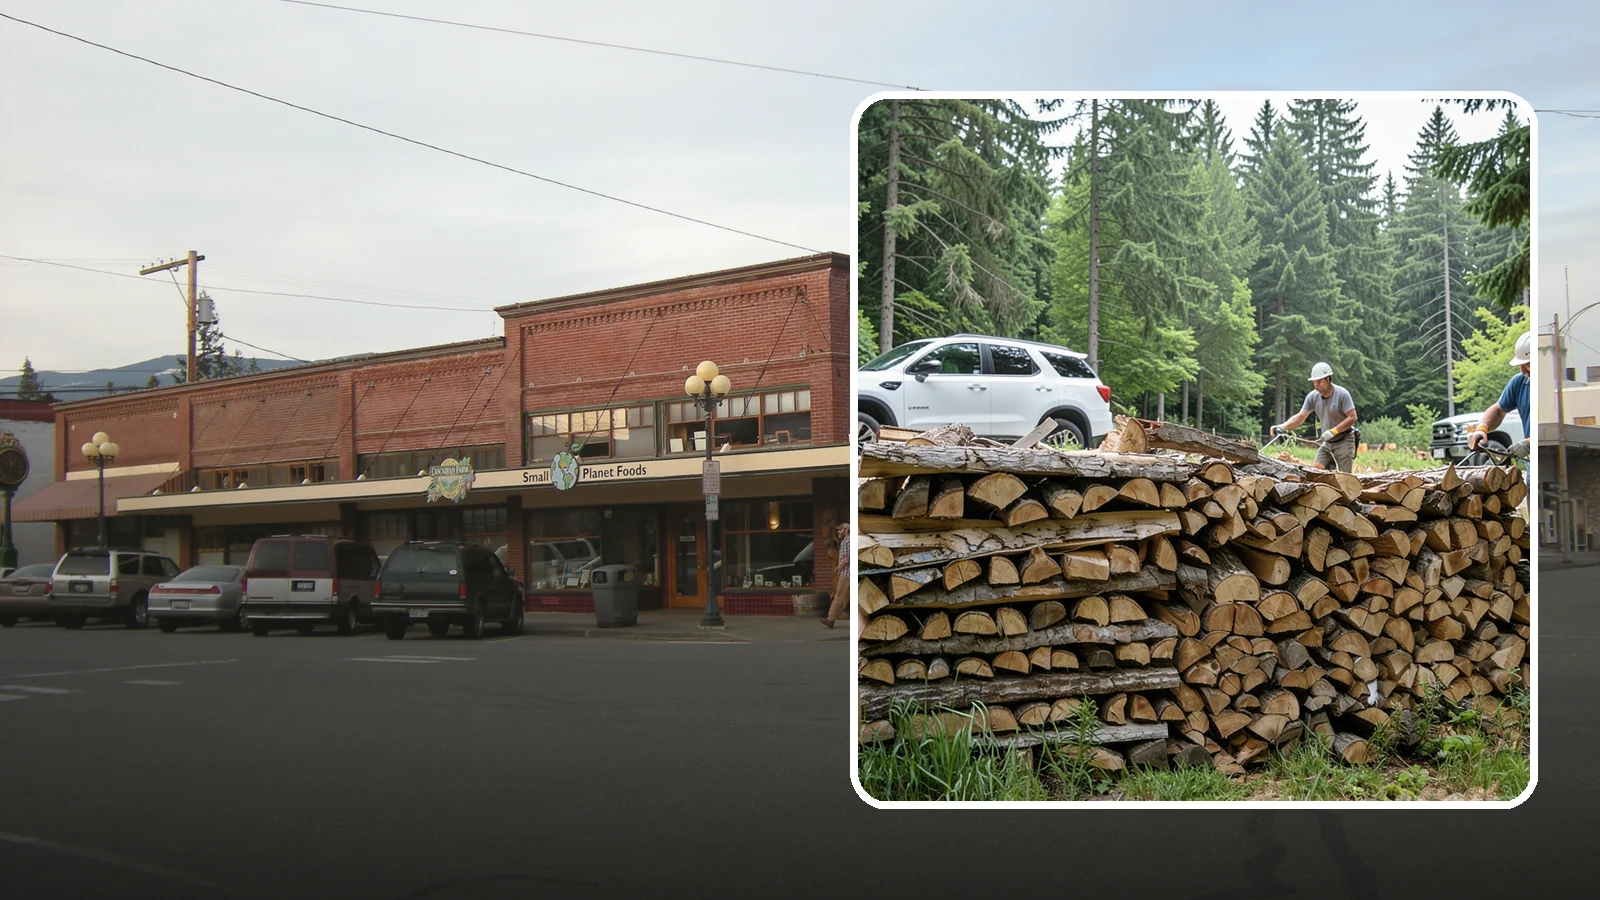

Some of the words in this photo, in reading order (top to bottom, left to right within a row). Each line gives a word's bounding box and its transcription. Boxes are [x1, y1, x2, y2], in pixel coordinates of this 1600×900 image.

[522, 471, 549, 483] Small
[582, 467, 614, 479] Planet
[616, 464, 647, 477] Foods
